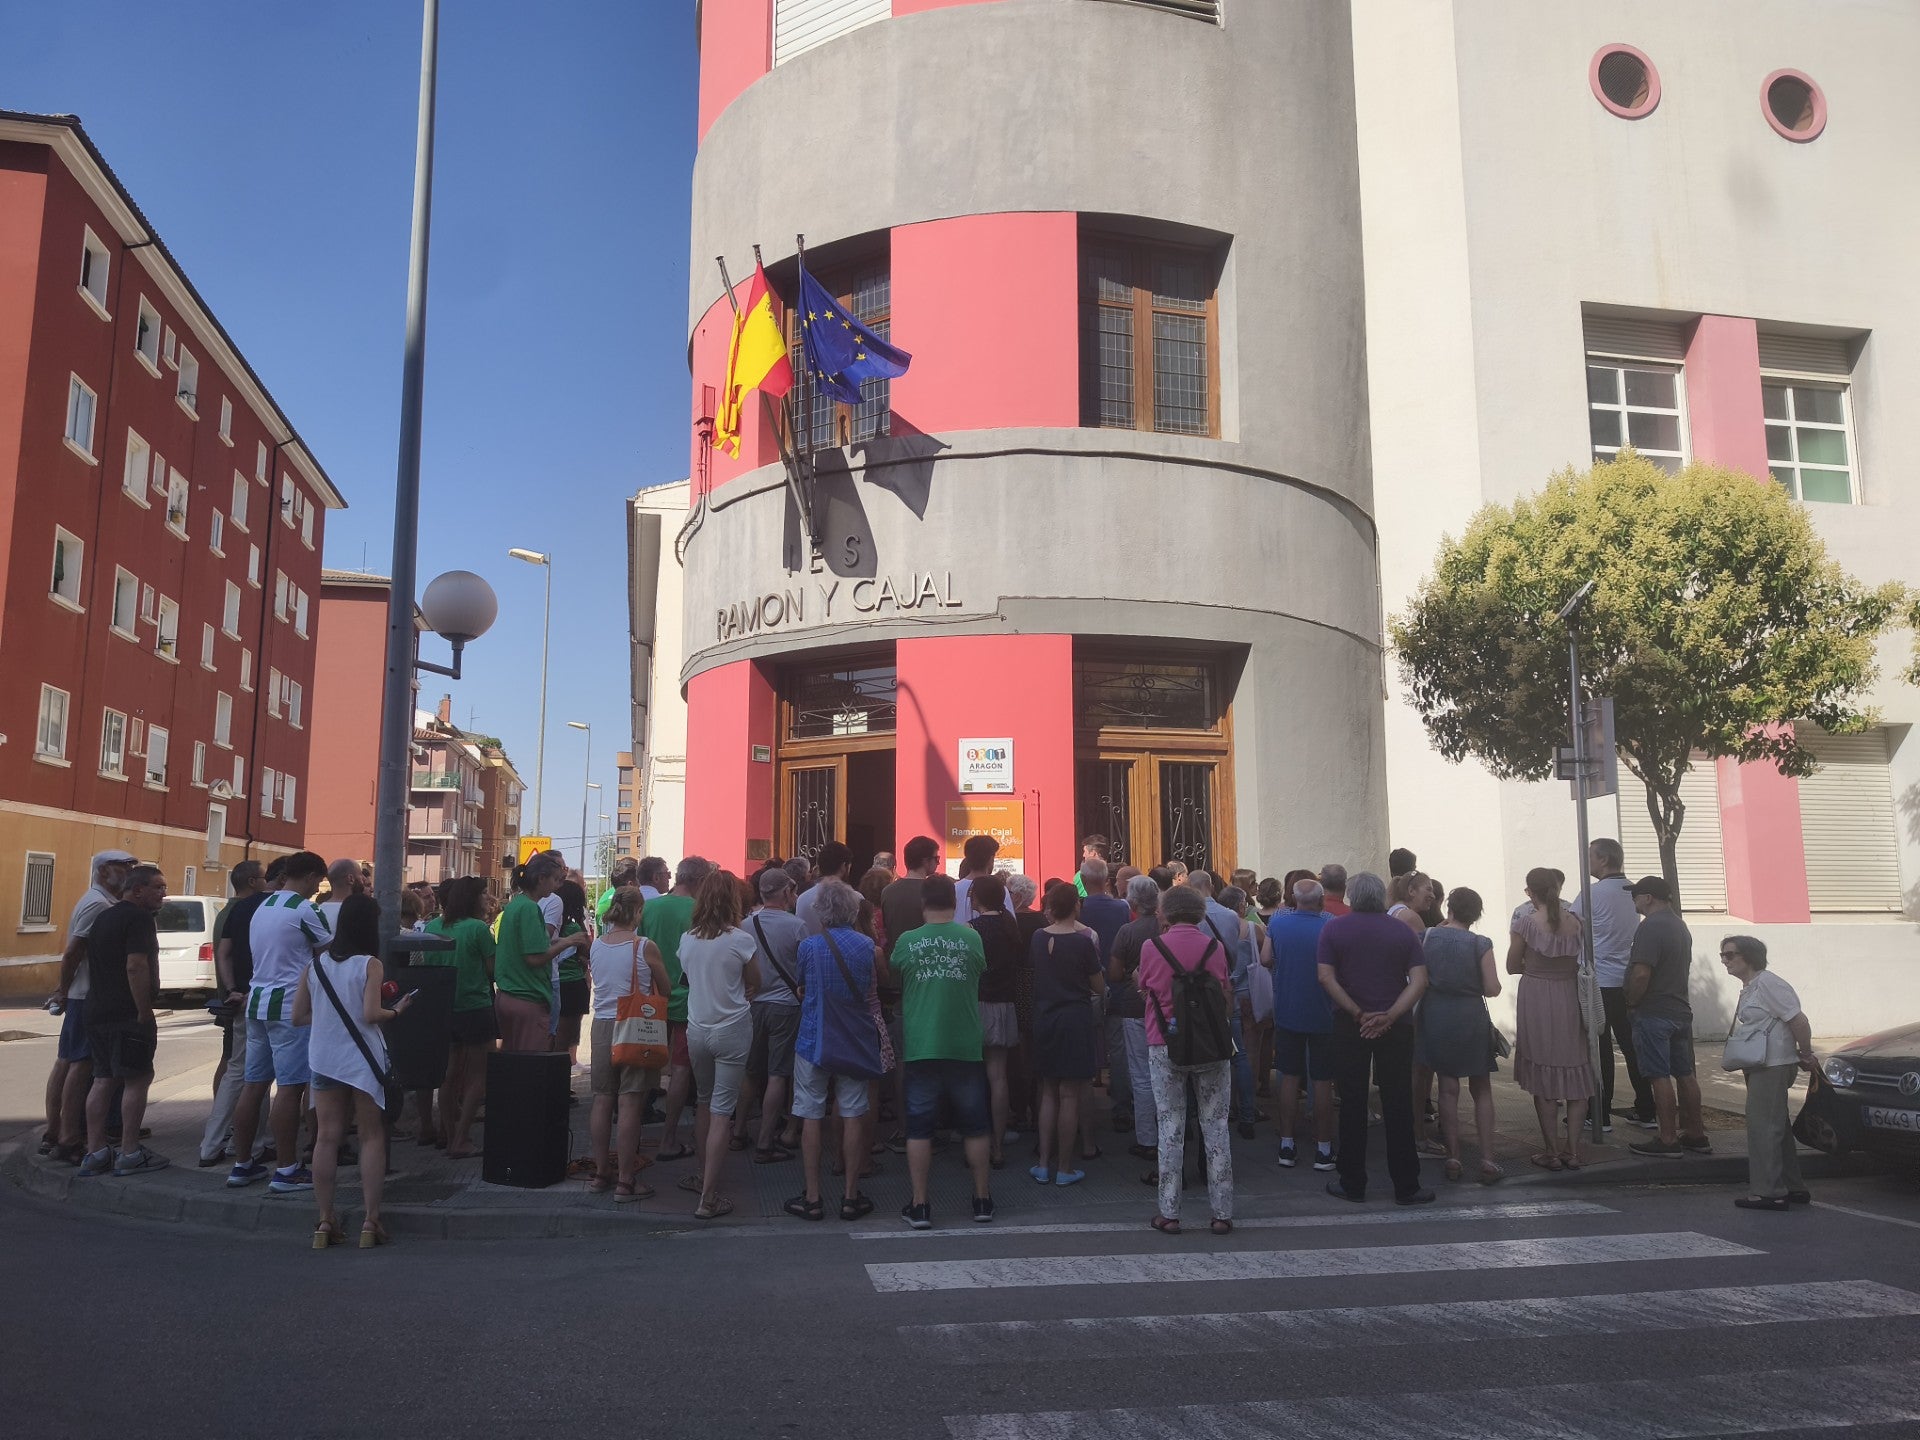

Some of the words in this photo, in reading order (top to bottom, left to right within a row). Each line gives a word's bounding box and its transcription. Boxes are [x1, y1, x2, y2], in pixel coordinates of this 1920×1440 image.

[716, 587, 803, 642] RAMON
[819, 581, 839, 617] Y
[852, 571, 963, 612] CAJAL
[951, 827, 981, 836] Ramón
[990, 827, 1013, 839] Cajal
[919, 957, 931, 966] DE
